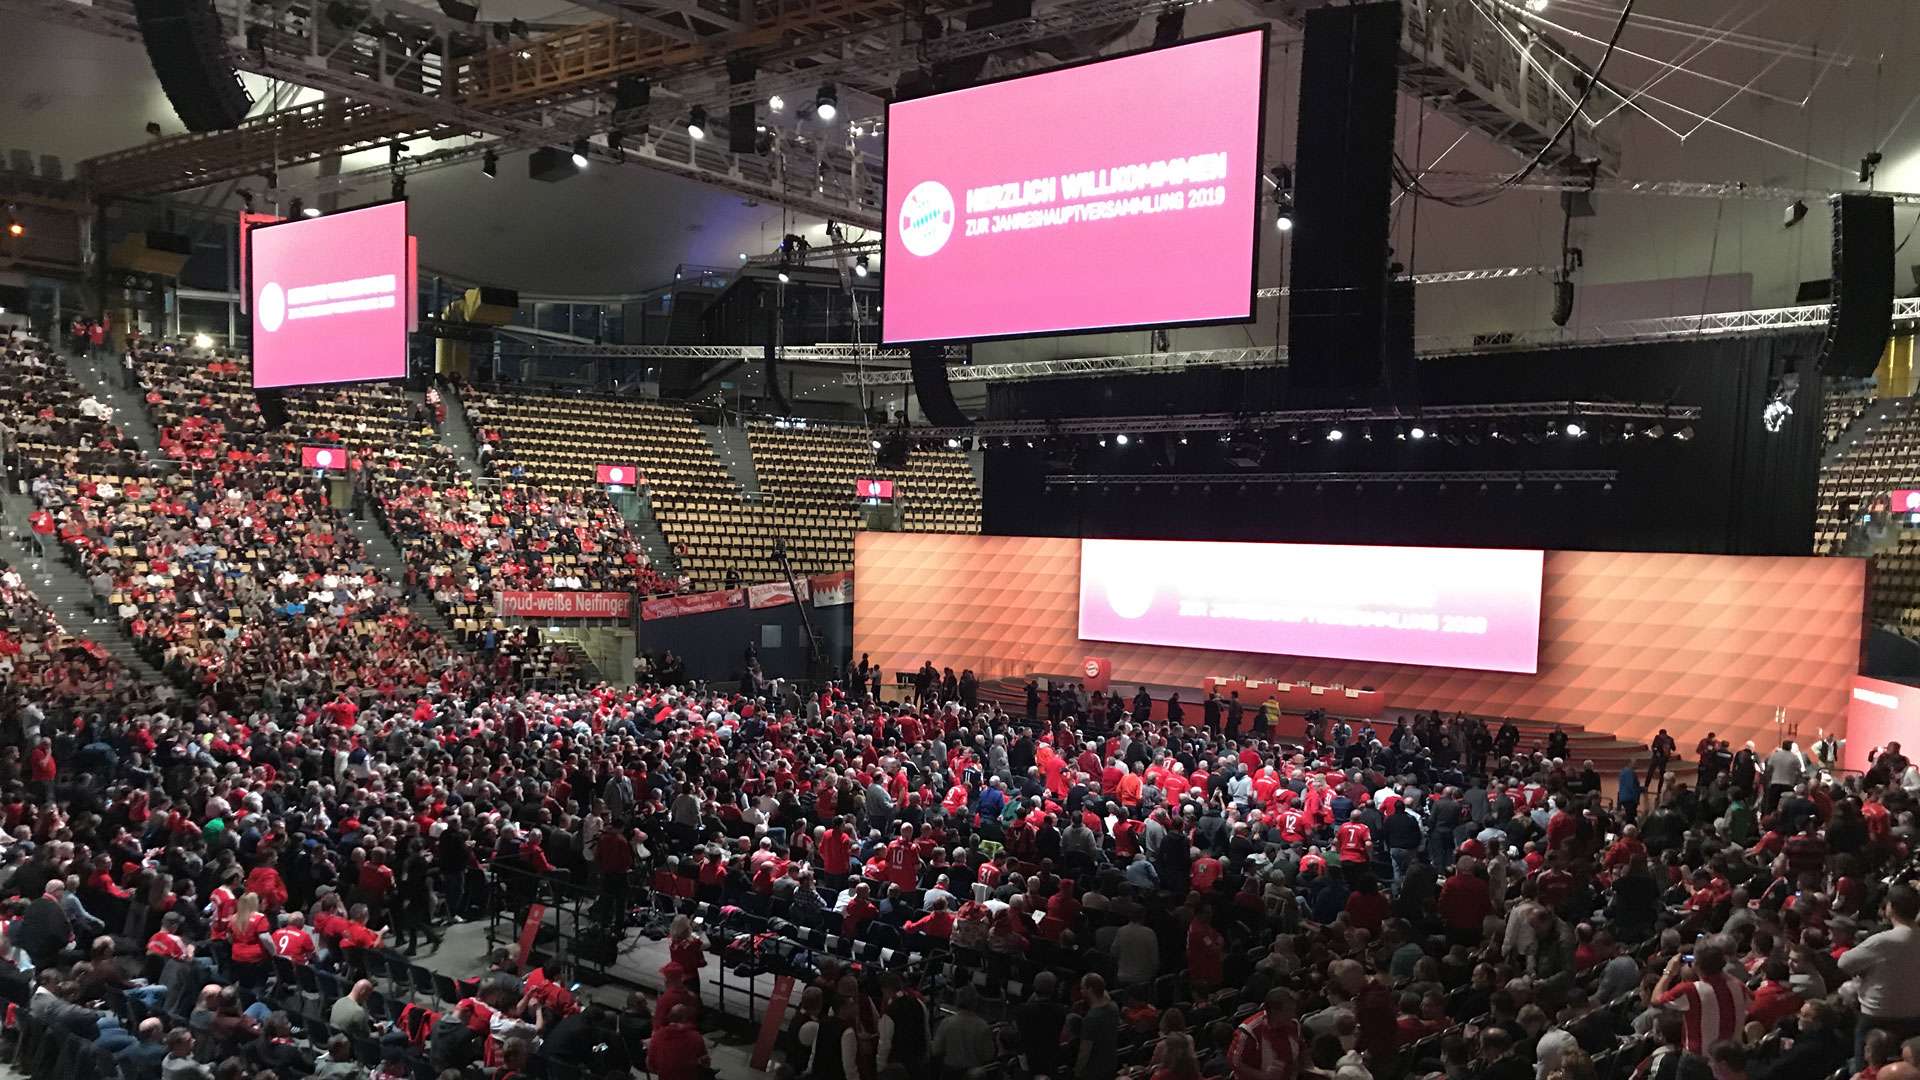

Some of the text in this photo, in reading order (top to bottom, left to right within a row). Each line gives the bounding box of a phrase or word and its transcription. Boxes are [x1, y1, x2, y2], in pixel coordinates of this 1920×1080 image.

[967, 152, 1227, 213] HERZLICH WILLKOMMEN
[966, 218, 989, 236] ZUR
[992, 191, 1184, 232] JAHRESHAUPTVERSAMMLUNG
[575, 593, 630, 616] Neifinger
[892, 849, 904, 865] 10
[279, 935, 289, 954] 9
